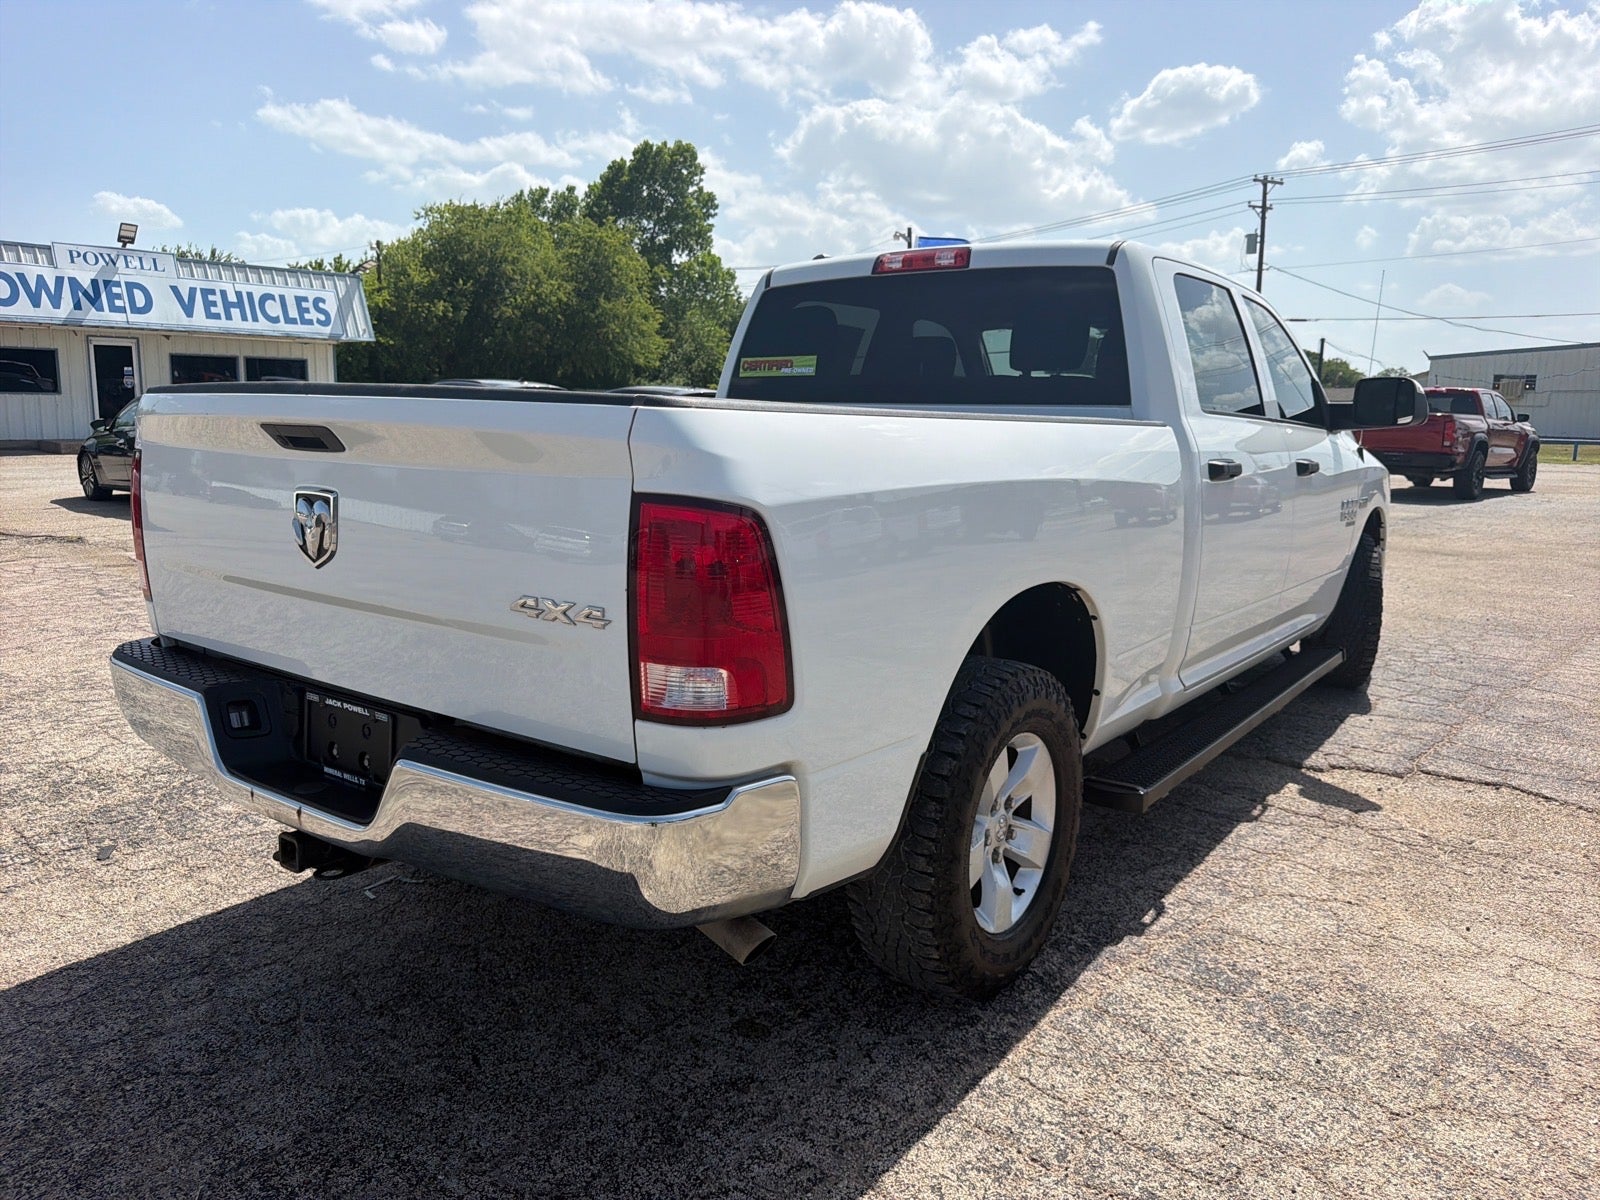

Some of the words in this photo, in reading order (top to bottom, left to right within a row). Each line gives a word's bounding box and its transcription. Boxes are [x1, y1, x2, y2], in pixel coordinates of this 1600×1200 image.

[68, 249, 166, 272] POWELL
[169, 285, 332, 327] VEHICLES
[742, 359, 794, 372] CERTIFIED
[325, 698, 342, 708] JACK
[343, 702, 370, 716] POWELL
